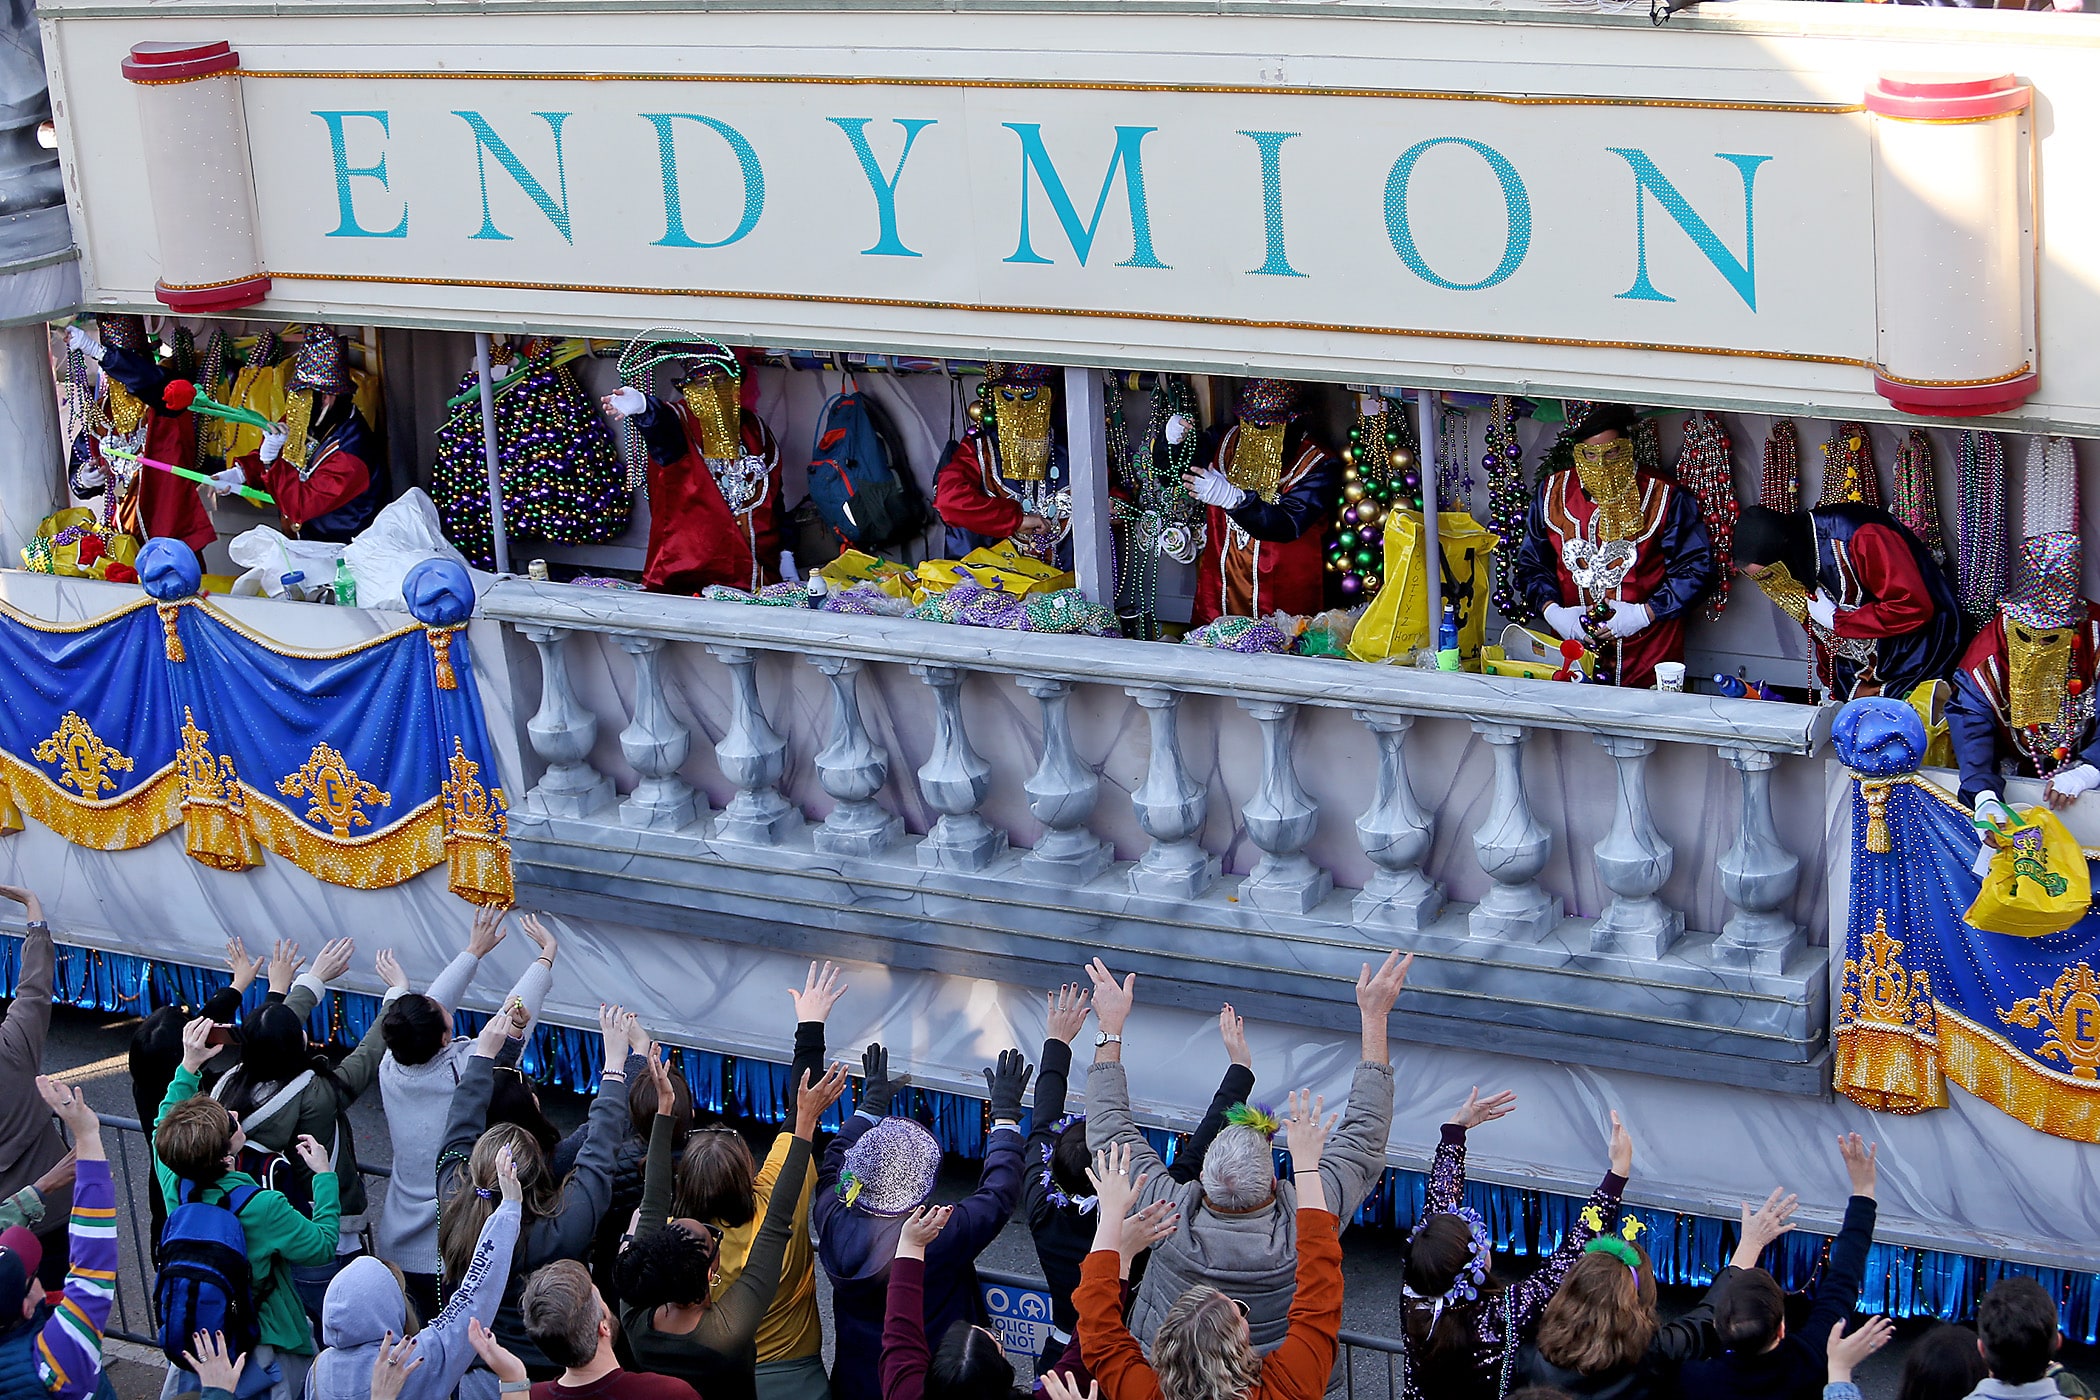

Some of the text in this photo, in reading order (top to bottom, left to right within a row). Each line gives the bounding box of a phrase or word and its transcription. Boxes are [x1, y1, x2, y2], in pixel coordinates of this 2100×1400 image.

[311, 110, 1774, 314] ENDYMION
[1400, 616, 1409, 627] 2
[74, 745, 90, 772] E
[193, 760, 203, 781] E
[325, 779, 342, 807] E
[462, 793, 474, 816] E
[1874, 976, 1888, 1002] E
[2076, 1007, 2095, 1042] E
[467, 1249, 490, 1283] SHOP
[469, 1260, 494, 1297] COLLECTION
[989, 1318, 1034, 1336] OLICE
[1005, 1333, 1035, 1350] NOT
